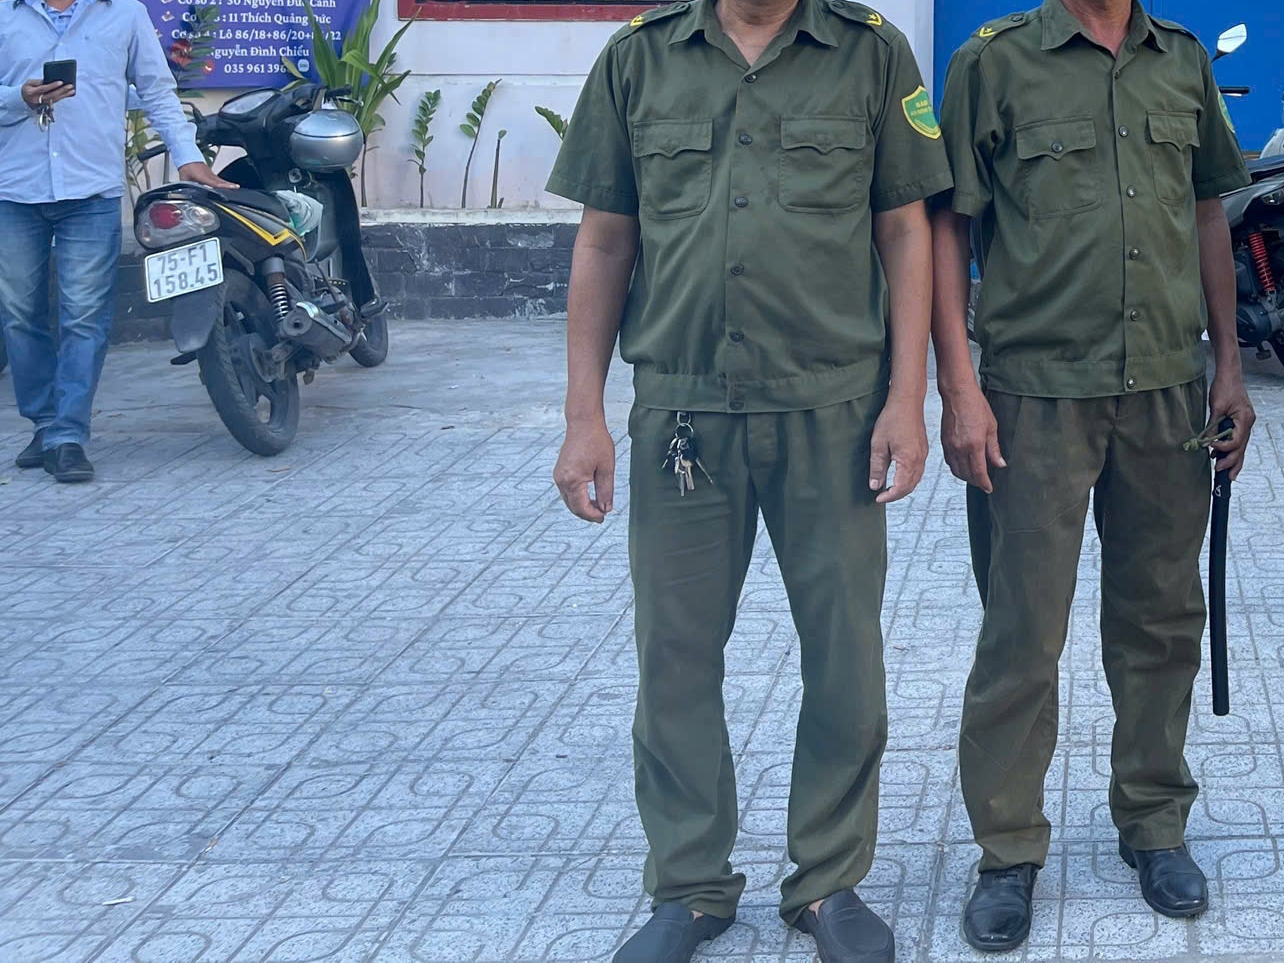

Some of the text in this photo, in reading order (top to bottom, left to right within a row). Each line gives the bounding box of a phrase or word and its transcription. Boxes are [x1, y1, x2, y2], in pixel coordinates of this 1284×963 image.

[229, 13, 238, 22] 11
[240, 12, 271, 23] Thích
[274, 13, 308, 26] Quảng
[219, 28, 233, 40] Lô
[235, 28, 341, 41] 86/18+86/20+/22
[250, 45, 277, 57] Đình
[224, 64, 244, 74] 035
[246, 64, 264, 74] 961
[157, 244, 208, 275] 75-F1
[153, 263, 218, 296] 158.45
